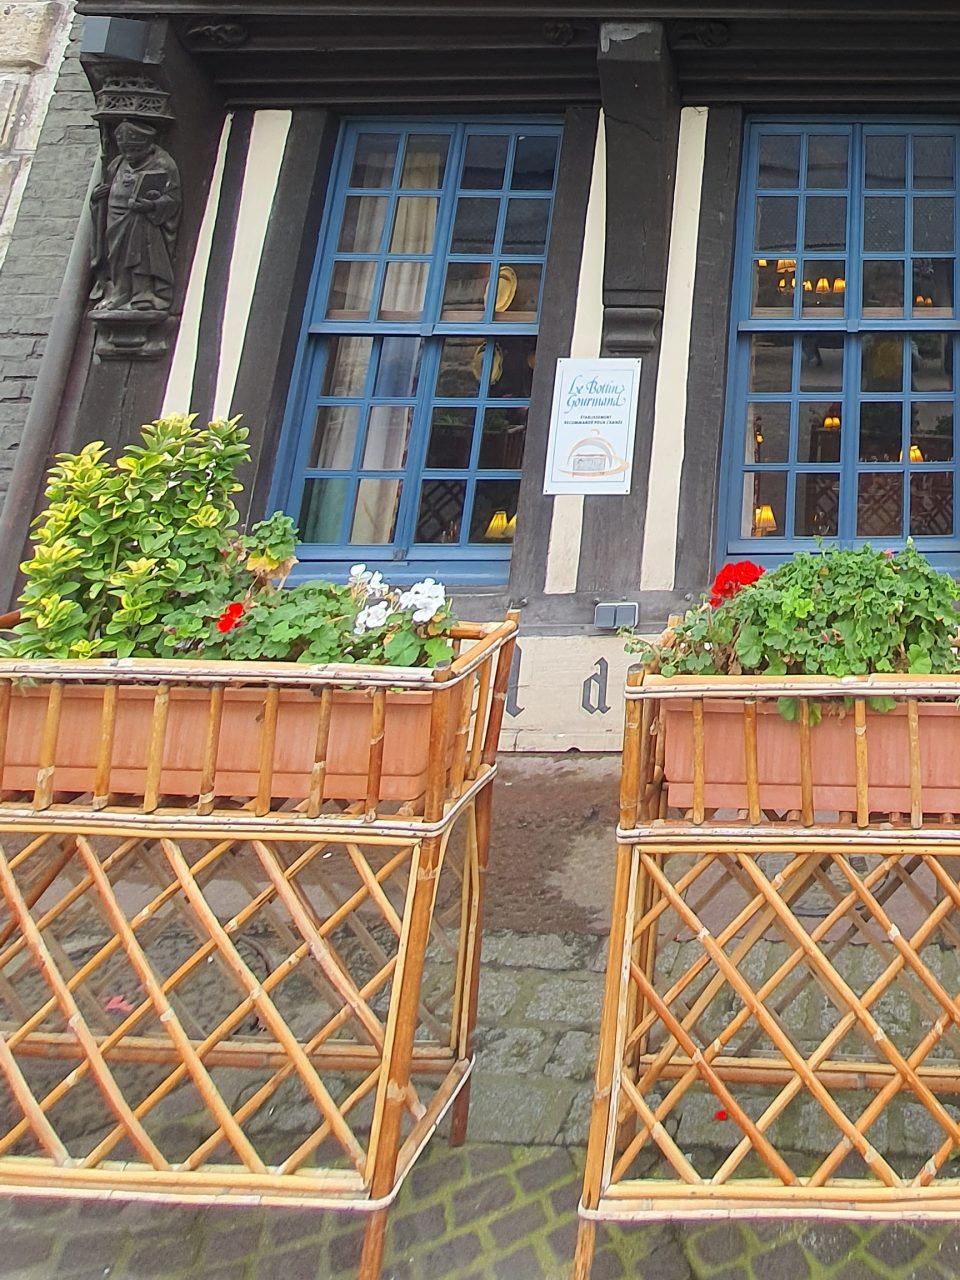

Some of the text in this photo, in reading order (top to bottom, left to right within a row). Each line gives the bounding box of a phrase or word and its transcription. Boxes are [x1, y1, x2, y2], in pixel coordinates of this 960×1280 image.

[568, 374, 625, 395] Le Bottin
[564, 394, 626, 414] Gourmand
